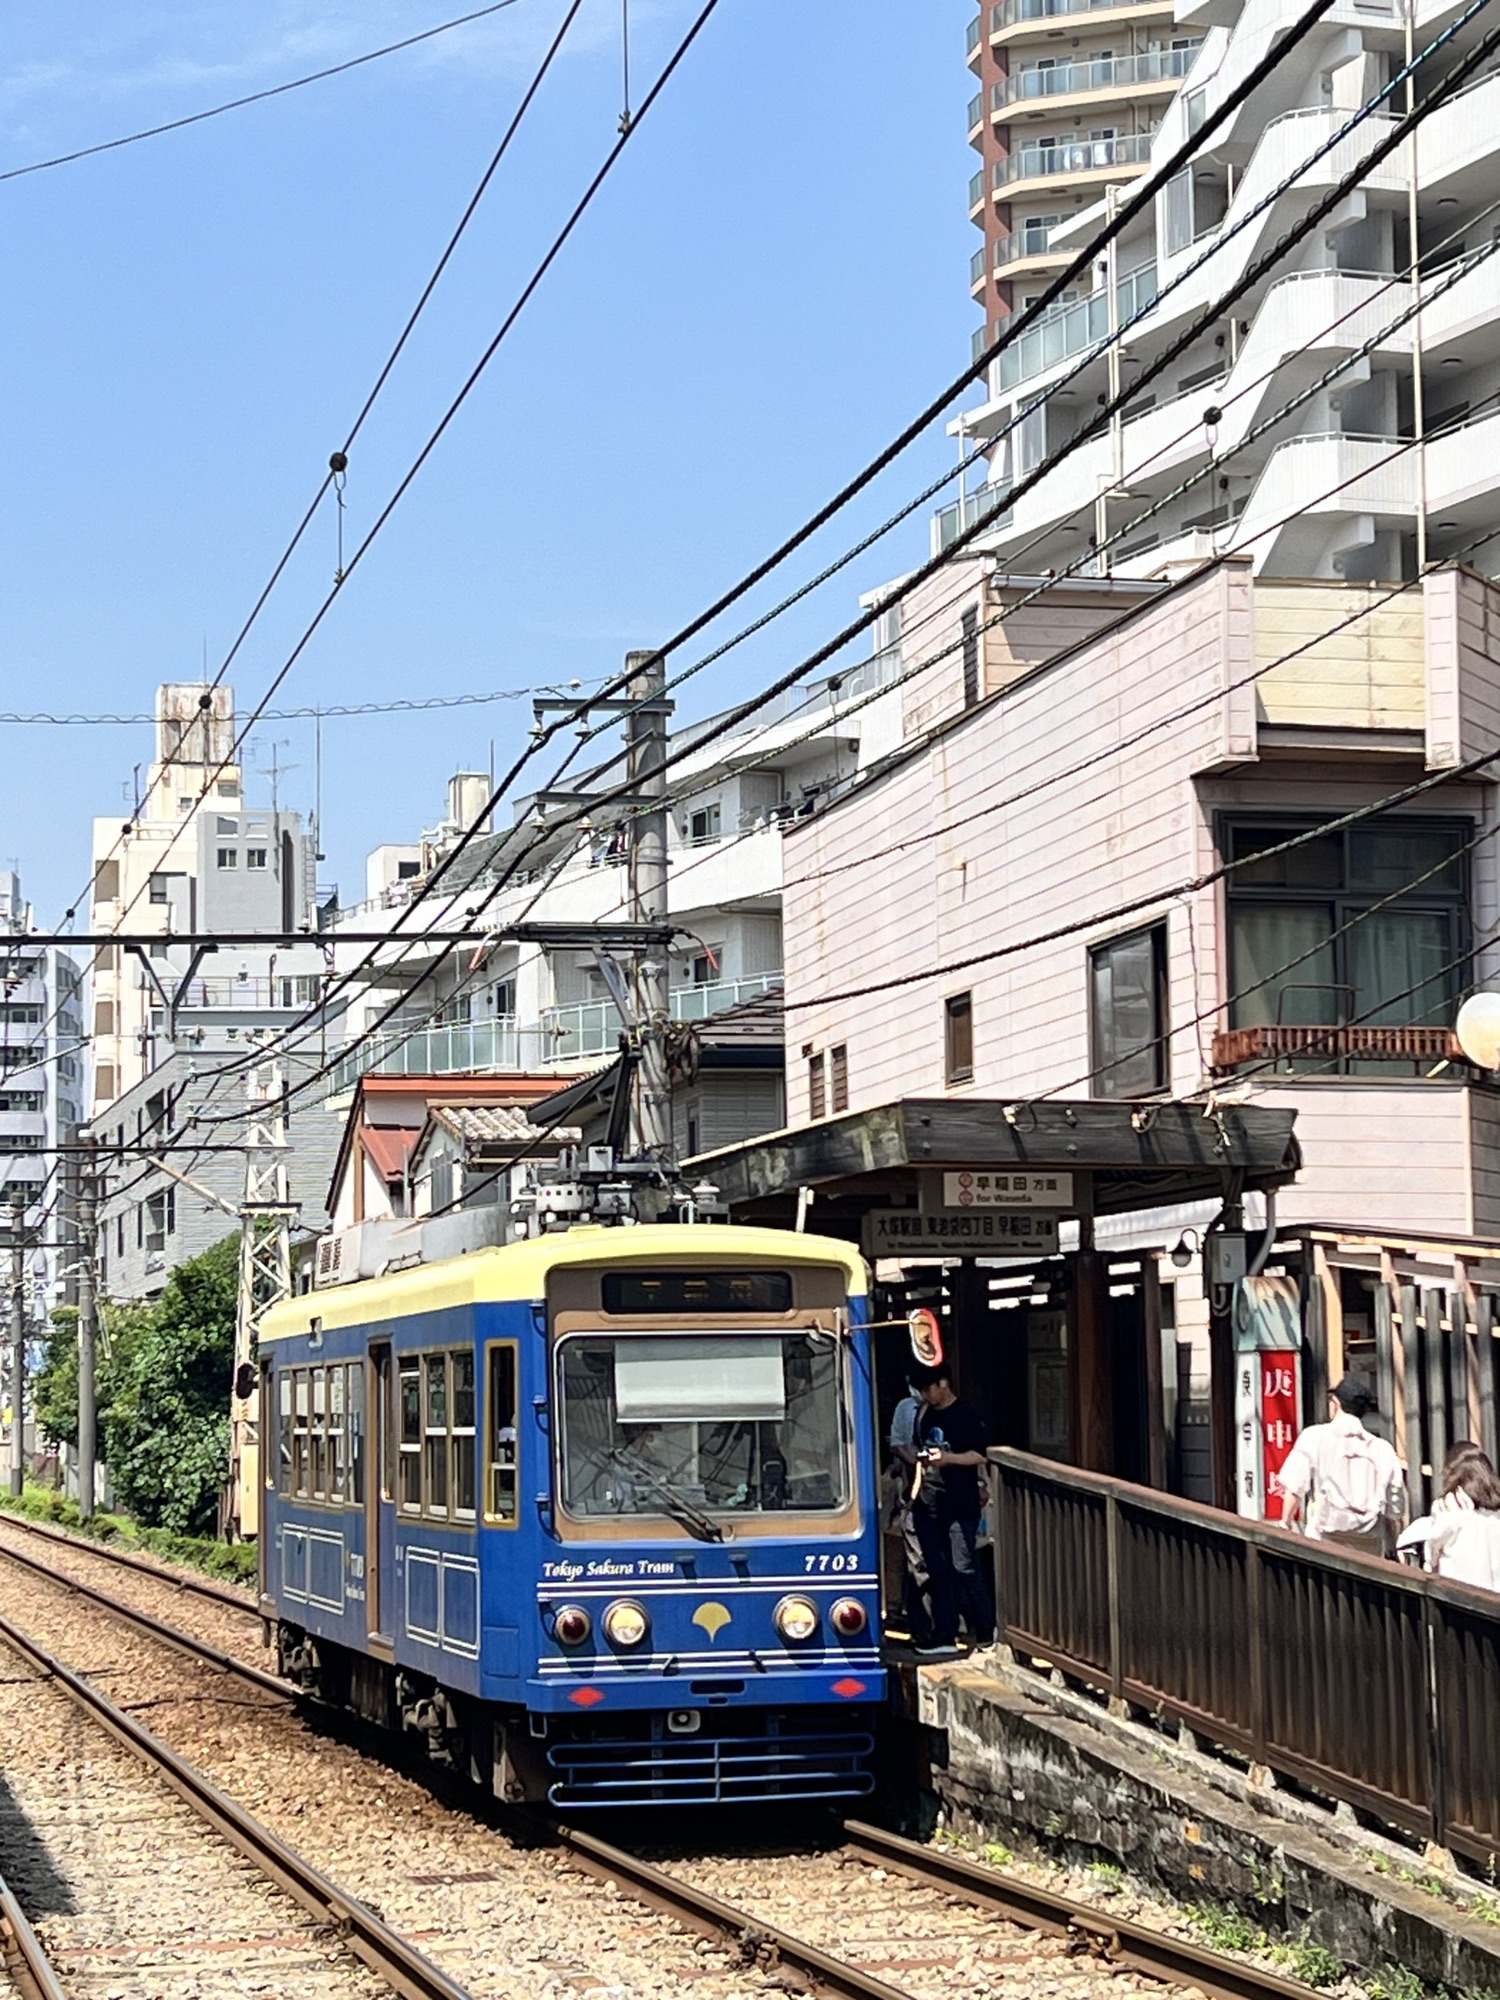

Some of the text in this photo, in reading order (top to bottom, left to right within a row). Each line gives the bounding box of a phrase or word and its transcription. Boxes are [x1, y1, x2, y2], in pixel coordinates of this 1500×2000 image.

[976, 1176, 1027, 1191] 早稲田
[976, 1194, 991, 1203] for
[543, 1558, 674, 1582] Tokyo Sakura Tram
[804, 1555, 858, 1571] 7703
